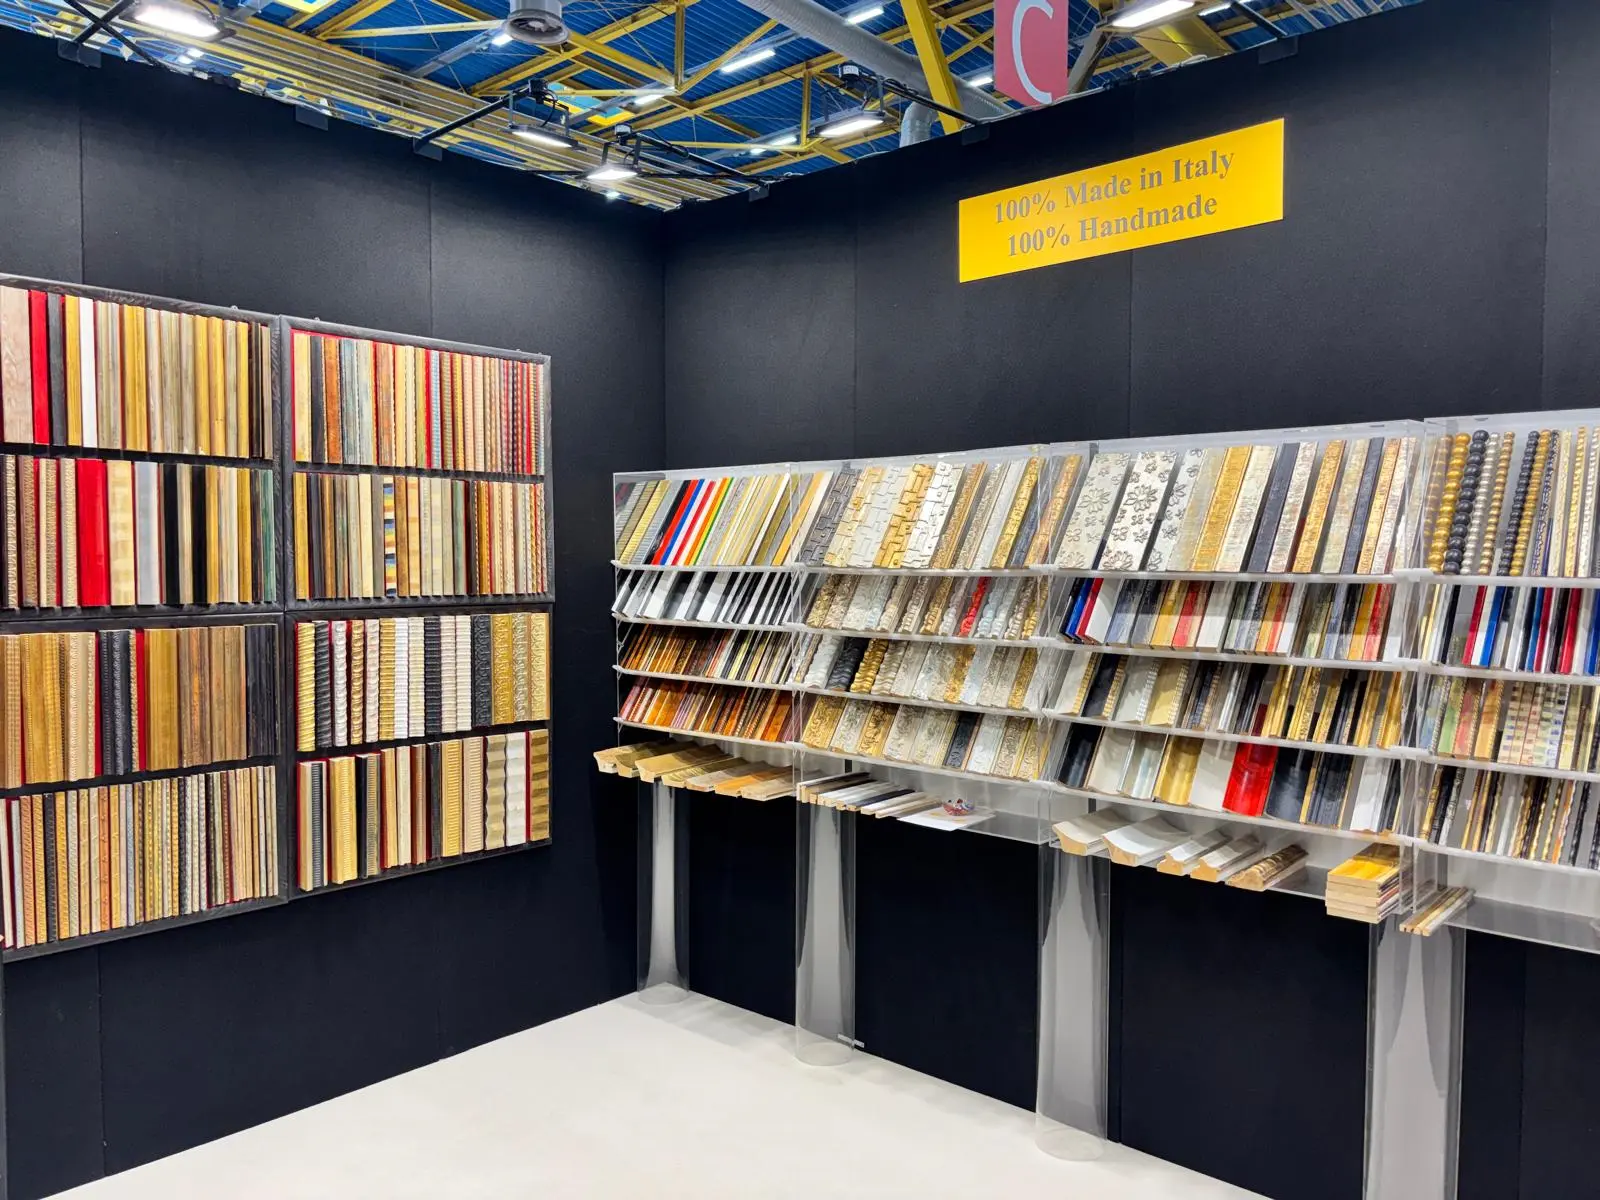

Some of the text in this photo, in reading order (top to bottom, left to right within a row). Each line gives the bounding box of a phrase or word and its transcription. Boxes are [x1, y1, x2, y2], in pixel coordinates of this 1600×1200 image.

[1012, 0, 1054, 104] C
[995, 150, 1234, 223] 100% Made in Italy
[1008, 194, 1218, 256] 100% Handmade
